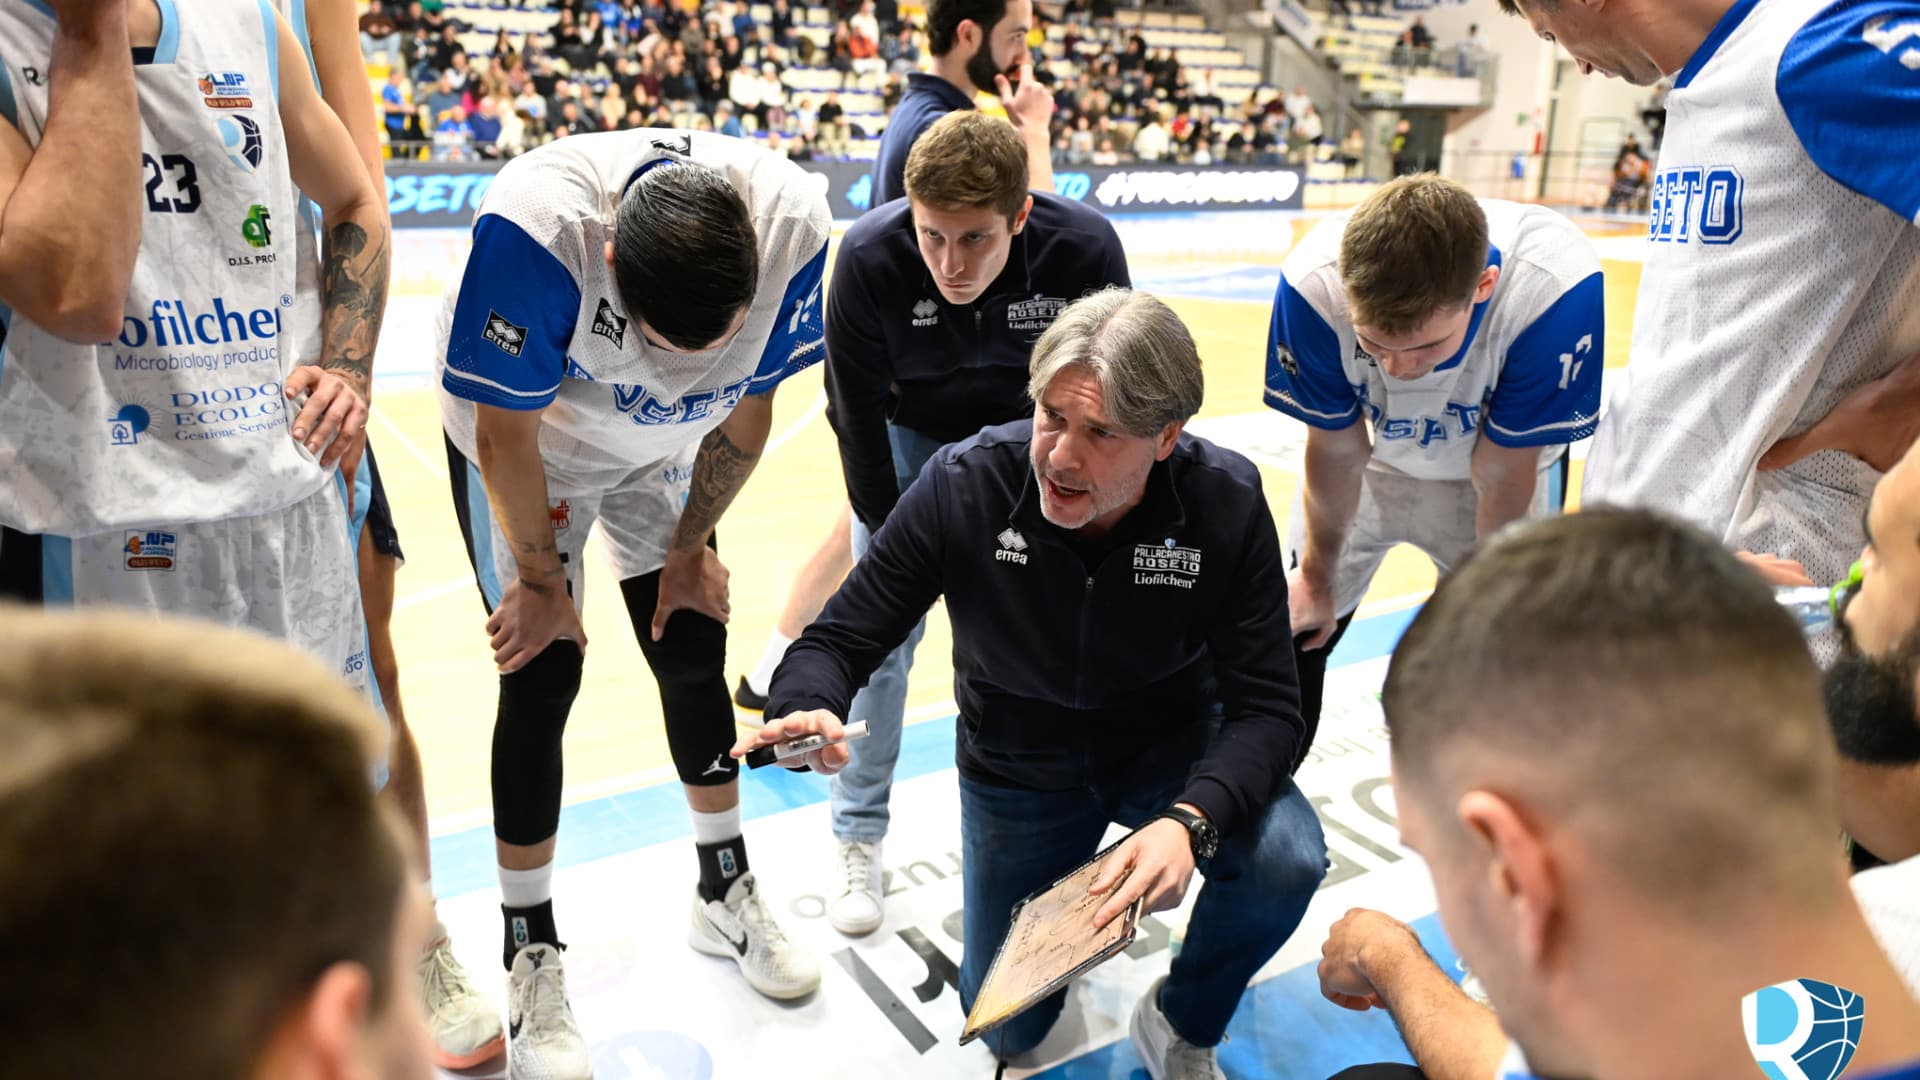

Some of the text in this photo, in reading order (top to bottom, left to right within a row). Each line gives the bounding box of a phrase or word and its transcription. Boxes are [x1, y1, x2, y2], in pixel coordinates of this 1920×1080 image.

[142, 152, 202, 213] 23
[1649, 165, 1745, 245] SETO
[911, 315, 939, 327] errea
[486, 328, 519, 355] errea
[594, 321, 623, 347] errea
[114, 346, 278, 371] Microbiology produc
[171, 381, 282, 408] DIODO
[995, 548, 1028, 566] errea
[1133, 557, 1200, 572] ROSETO
[1134, 547, 1201, 562] PALLACANESTRO
